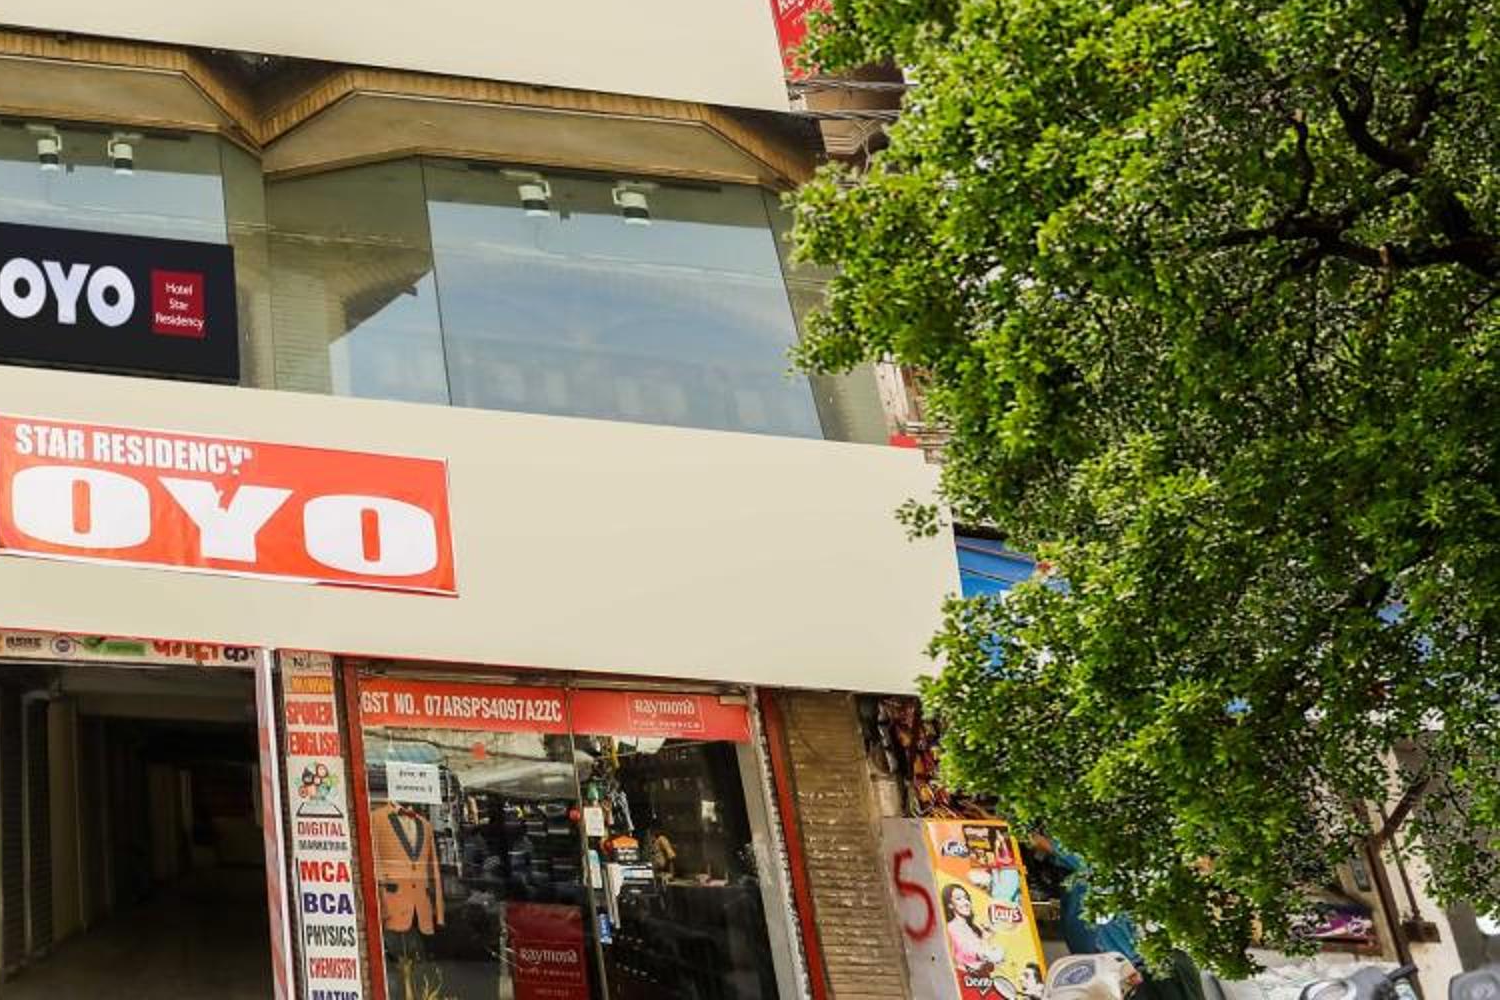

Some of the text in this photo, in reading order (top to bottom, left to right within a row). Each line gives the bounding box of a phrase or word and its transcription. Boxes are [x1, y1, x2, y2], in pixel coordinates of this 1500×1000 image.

[165, 283, 193, 296] Hotel
[168, 298, 189, 311] Star
[155, 313, 204, 330] Residency
[14, 423, 85, 460] STAR
[11, 465, 438, 577] OYO
[361, 691, 389, 713] GST
[393, 692, 420, 715] NO.
[634, 698, 695, 717] Raymond
[297, 821, 346, 837] DIGITAL
[301, 860, 350, 883] MCA
[303, 892, 354, 915] BCA
[893, 848, 936, 943] 5
[306, 925, 356, 947] PHYSICS
[519, 947, 578, 965] Raymond
[310, 957, 357, 980] CHEMISTRY
